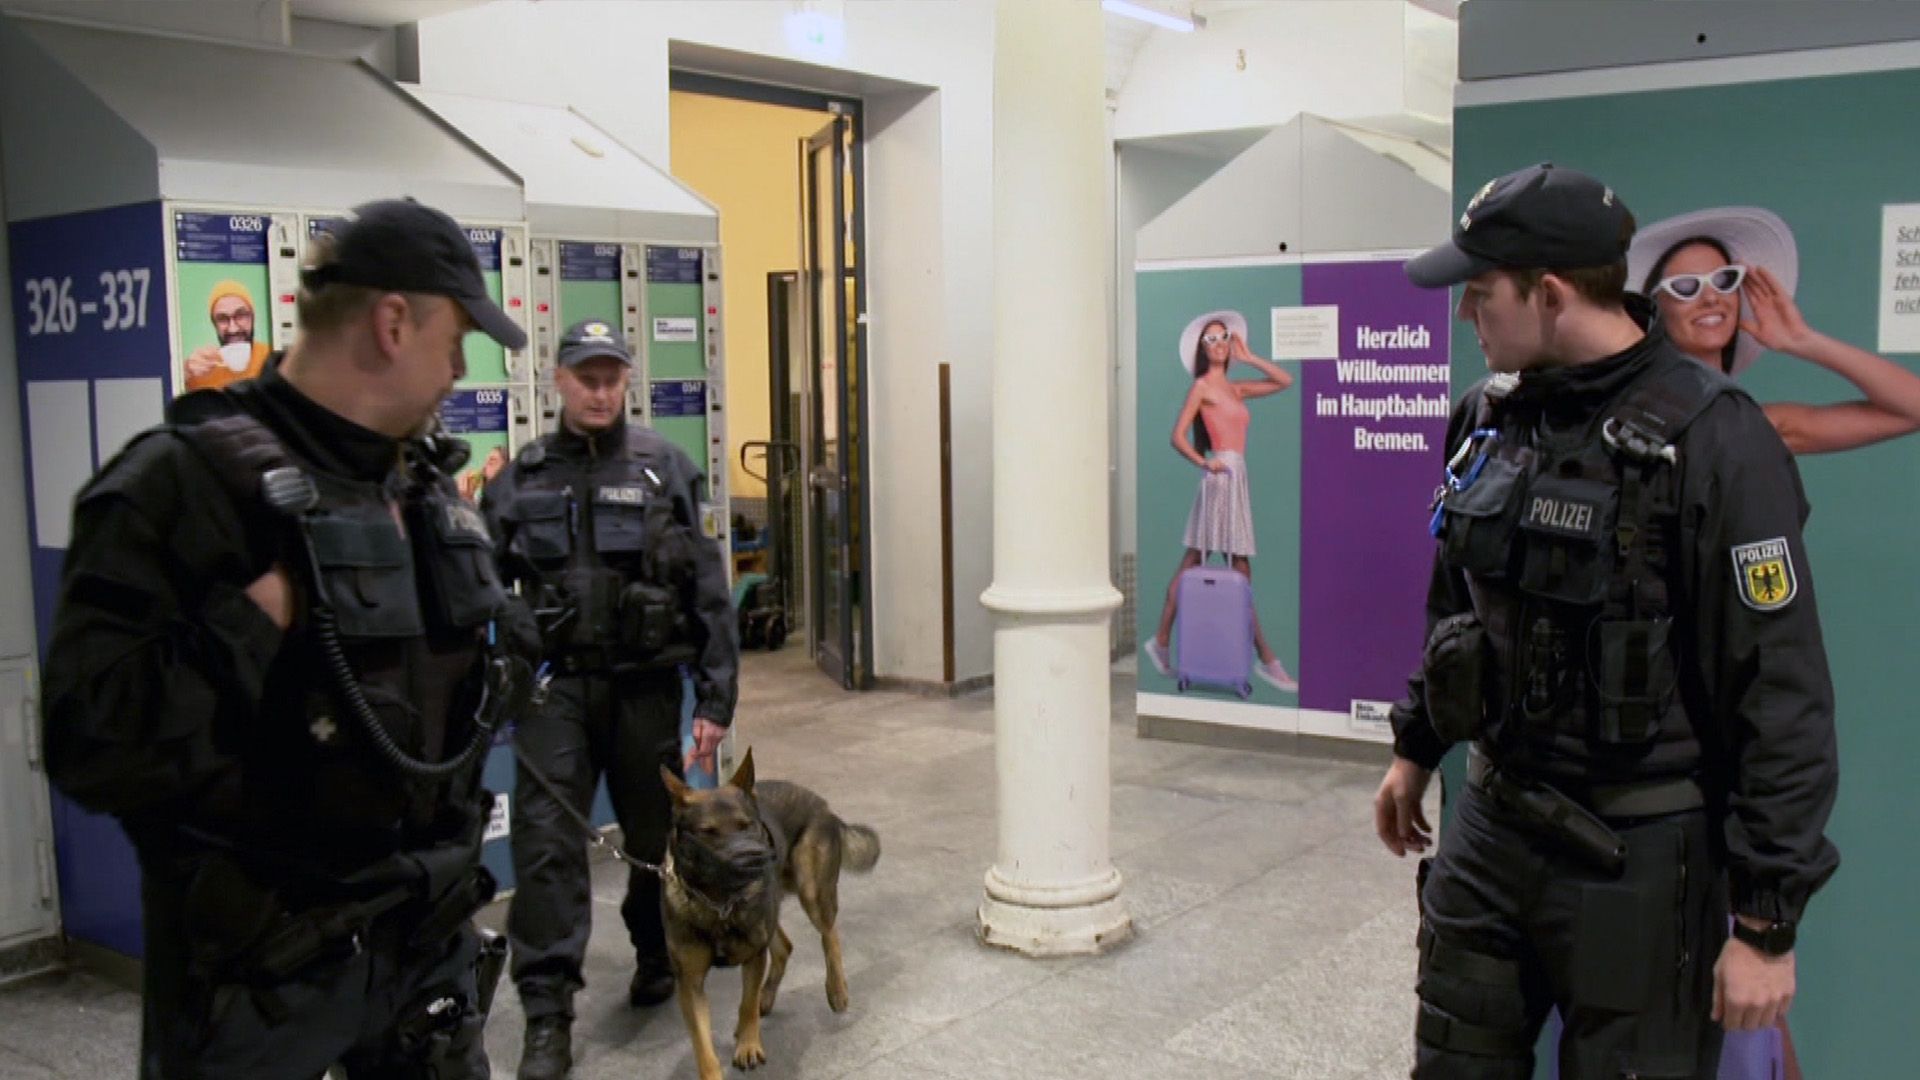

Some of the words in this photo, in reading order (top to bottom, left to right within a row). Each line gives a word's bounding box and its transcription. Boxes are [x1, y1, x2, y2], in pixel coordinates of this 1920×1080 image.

[229, 216, 263, 232] 0326
[470, 229, 496, 243] 0334
[1356, 325, 1430, 349] Herzlich
[1336, 359, 1449, 383] Willkommen
[476, 390, 503, 404] 0335
[1316, 394, 1338, 416] im
[1354, 427, 1429, 451] Bremen.
[1529, 497, 1593, 532] POLIZEI
[1738, 542, 1784, 565] POLIZEI
